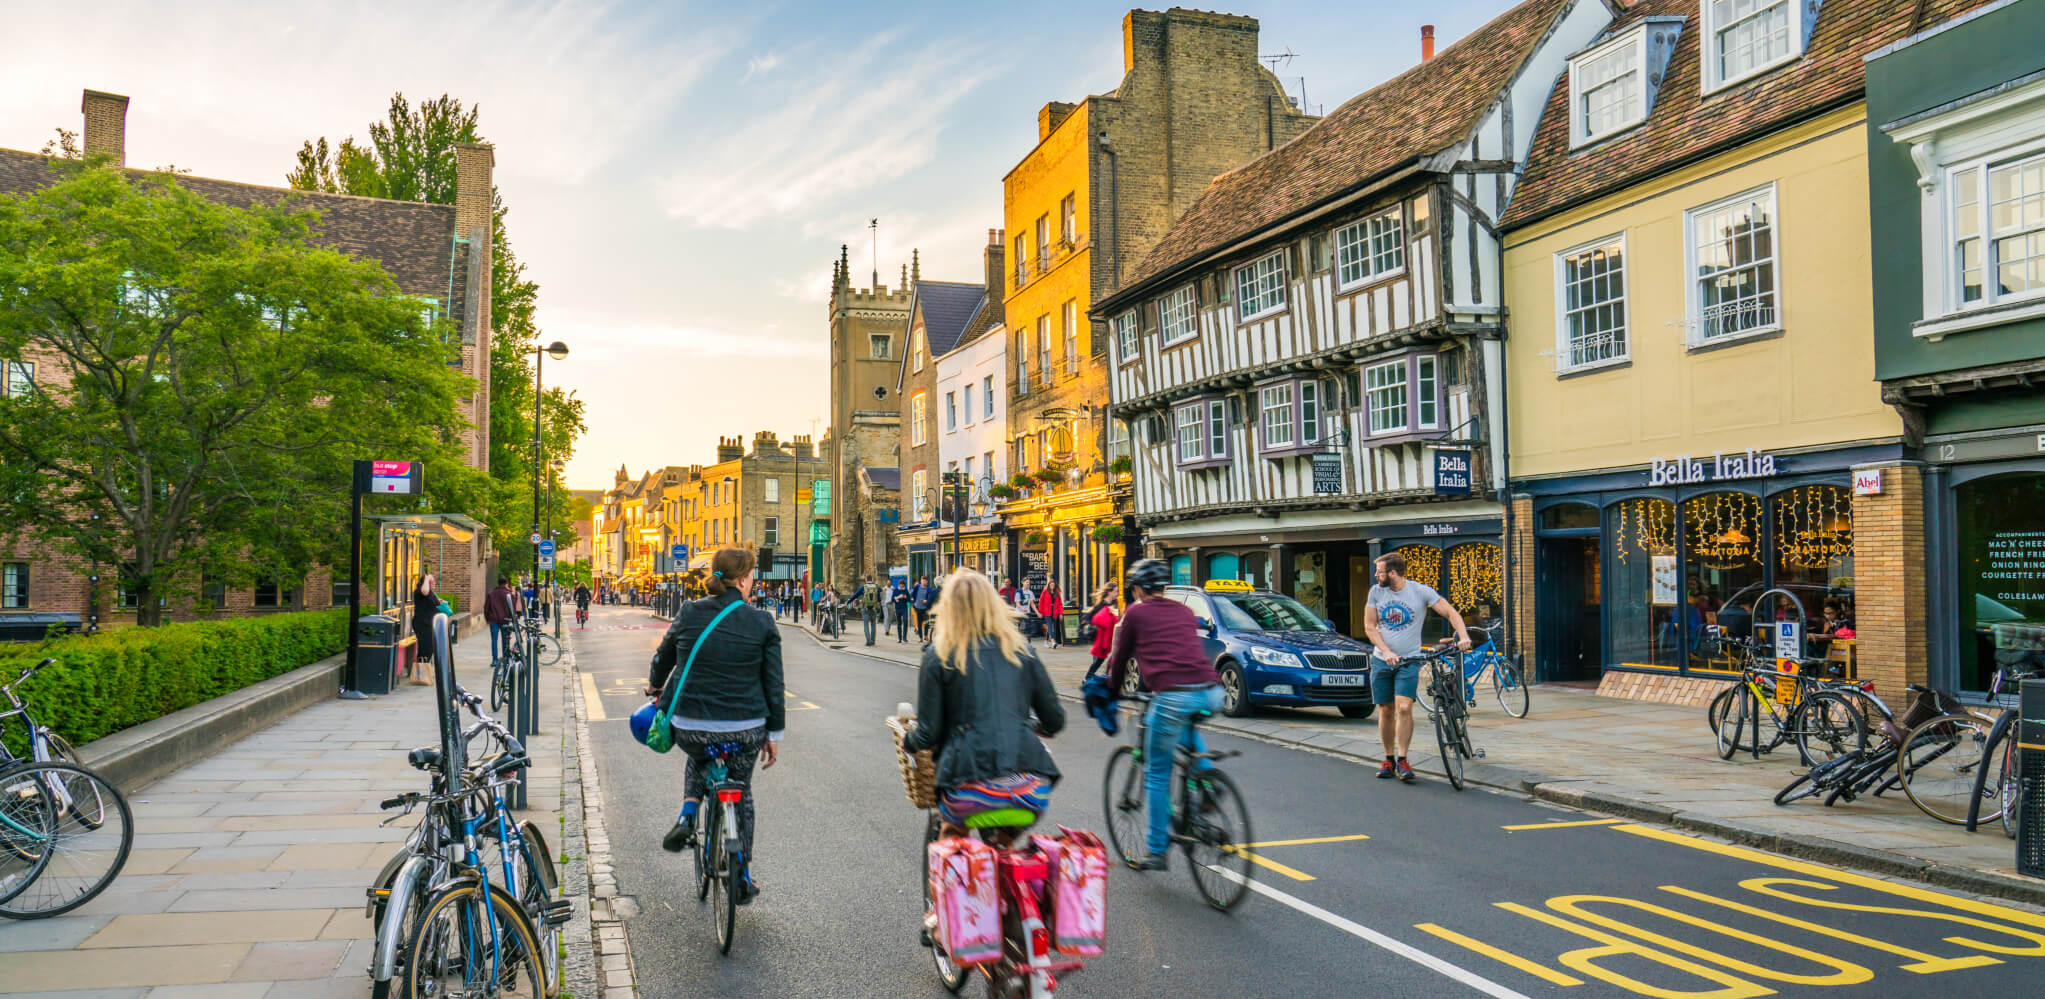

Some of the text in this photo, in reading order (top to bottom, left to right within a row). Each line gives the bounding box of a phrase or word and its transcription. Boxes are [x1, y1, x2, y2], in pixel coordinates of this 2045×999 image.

[1939, 445, 1955, 460] 12
[1439, 456, 1467, 471] Bella
[1648, 447, 1776, 487] Bella Italia
[1314, 481, 1341, 492] ARTS
[1439, 473, 1468, 488] Italia
[1856, 475, 1879, 488] Abel
[1424, 525, 1438, 534] Bella
[1981, 571, 2033, 579] COURGETTE
[1998, 592, 2045, 600] COLESLAW
[1344, 675, 1359, 684] NCY
